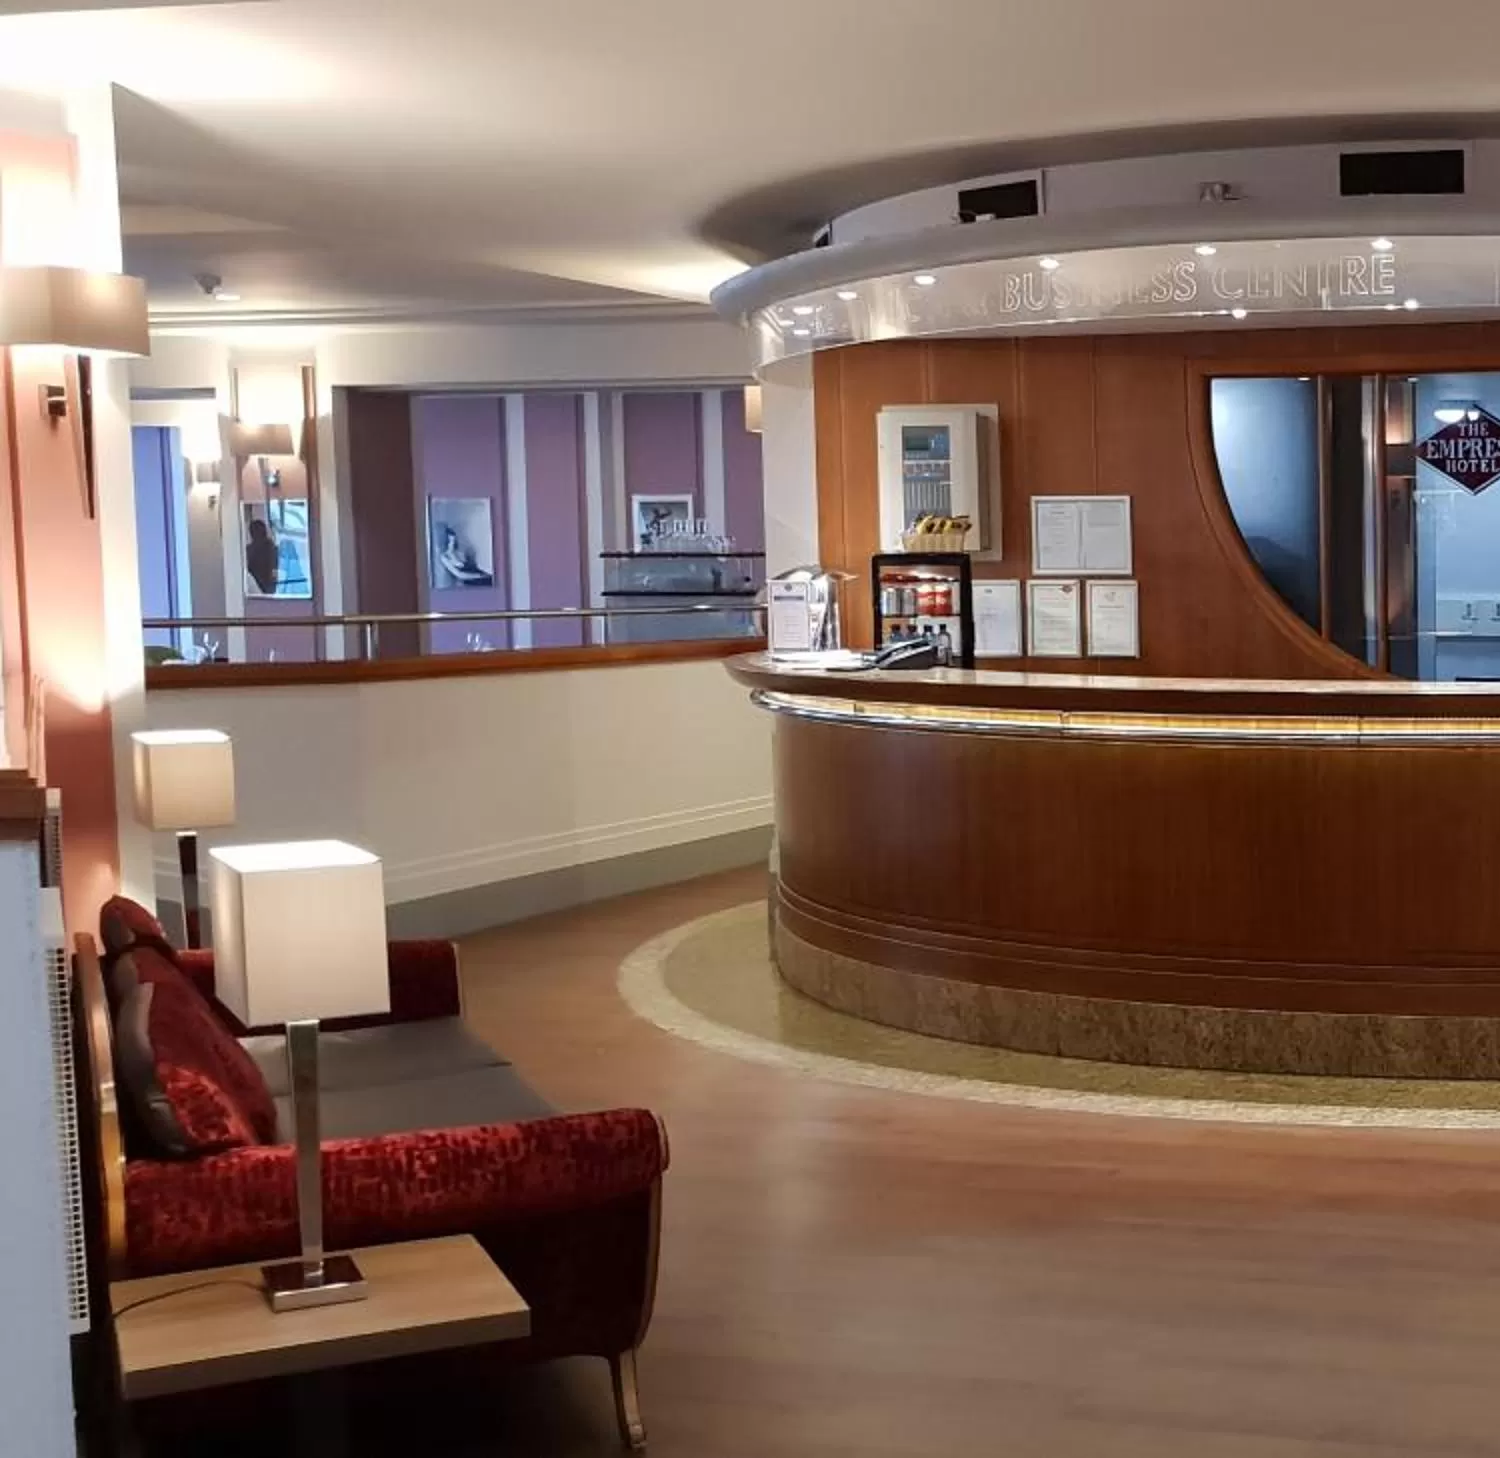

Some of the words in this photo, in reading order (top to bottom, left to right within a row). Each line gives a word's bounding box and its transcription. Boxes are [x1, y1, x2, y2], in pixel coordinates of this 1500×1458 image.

[999, 260, 1198, 312] BUSIESS
[1458, 421, 1489, 437] THE
[1445, 459, 1500, 473] HOTEL
